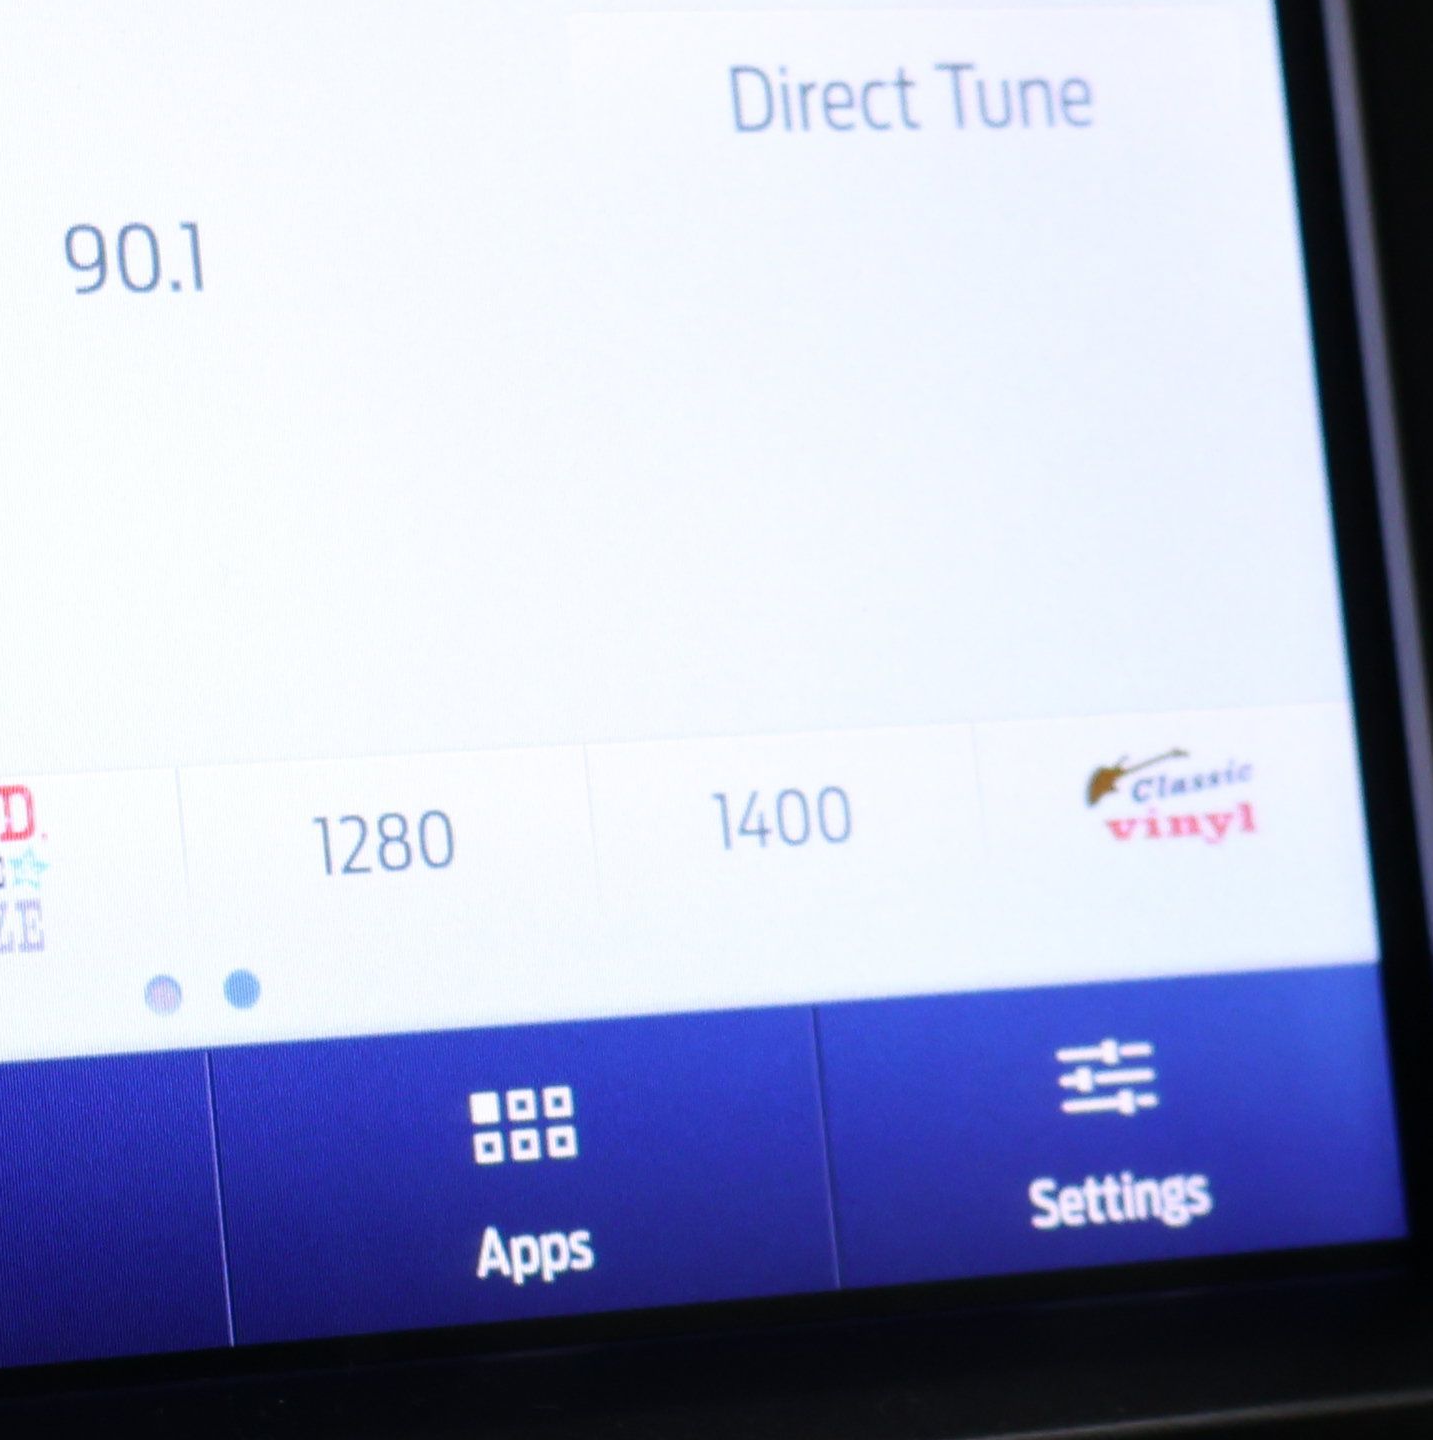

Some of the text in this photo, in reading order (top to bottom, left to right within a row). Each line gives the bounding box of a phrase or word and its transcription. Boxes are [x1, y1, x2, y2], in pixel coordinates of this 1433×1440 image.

[729, 62, 1092, 133] Direct Tune
[65, 222, 203, 294] 90.1
[1132, 759, 1252, 802] Classic
[313, 810, 454, 875] 1280
[712, 786, 851, 850] 1400
[1106, 801, 1257, 844] vinyl
[1029, 1172, 1211, 1228] Settings
[477, 1227, 594, 1285] Apps
